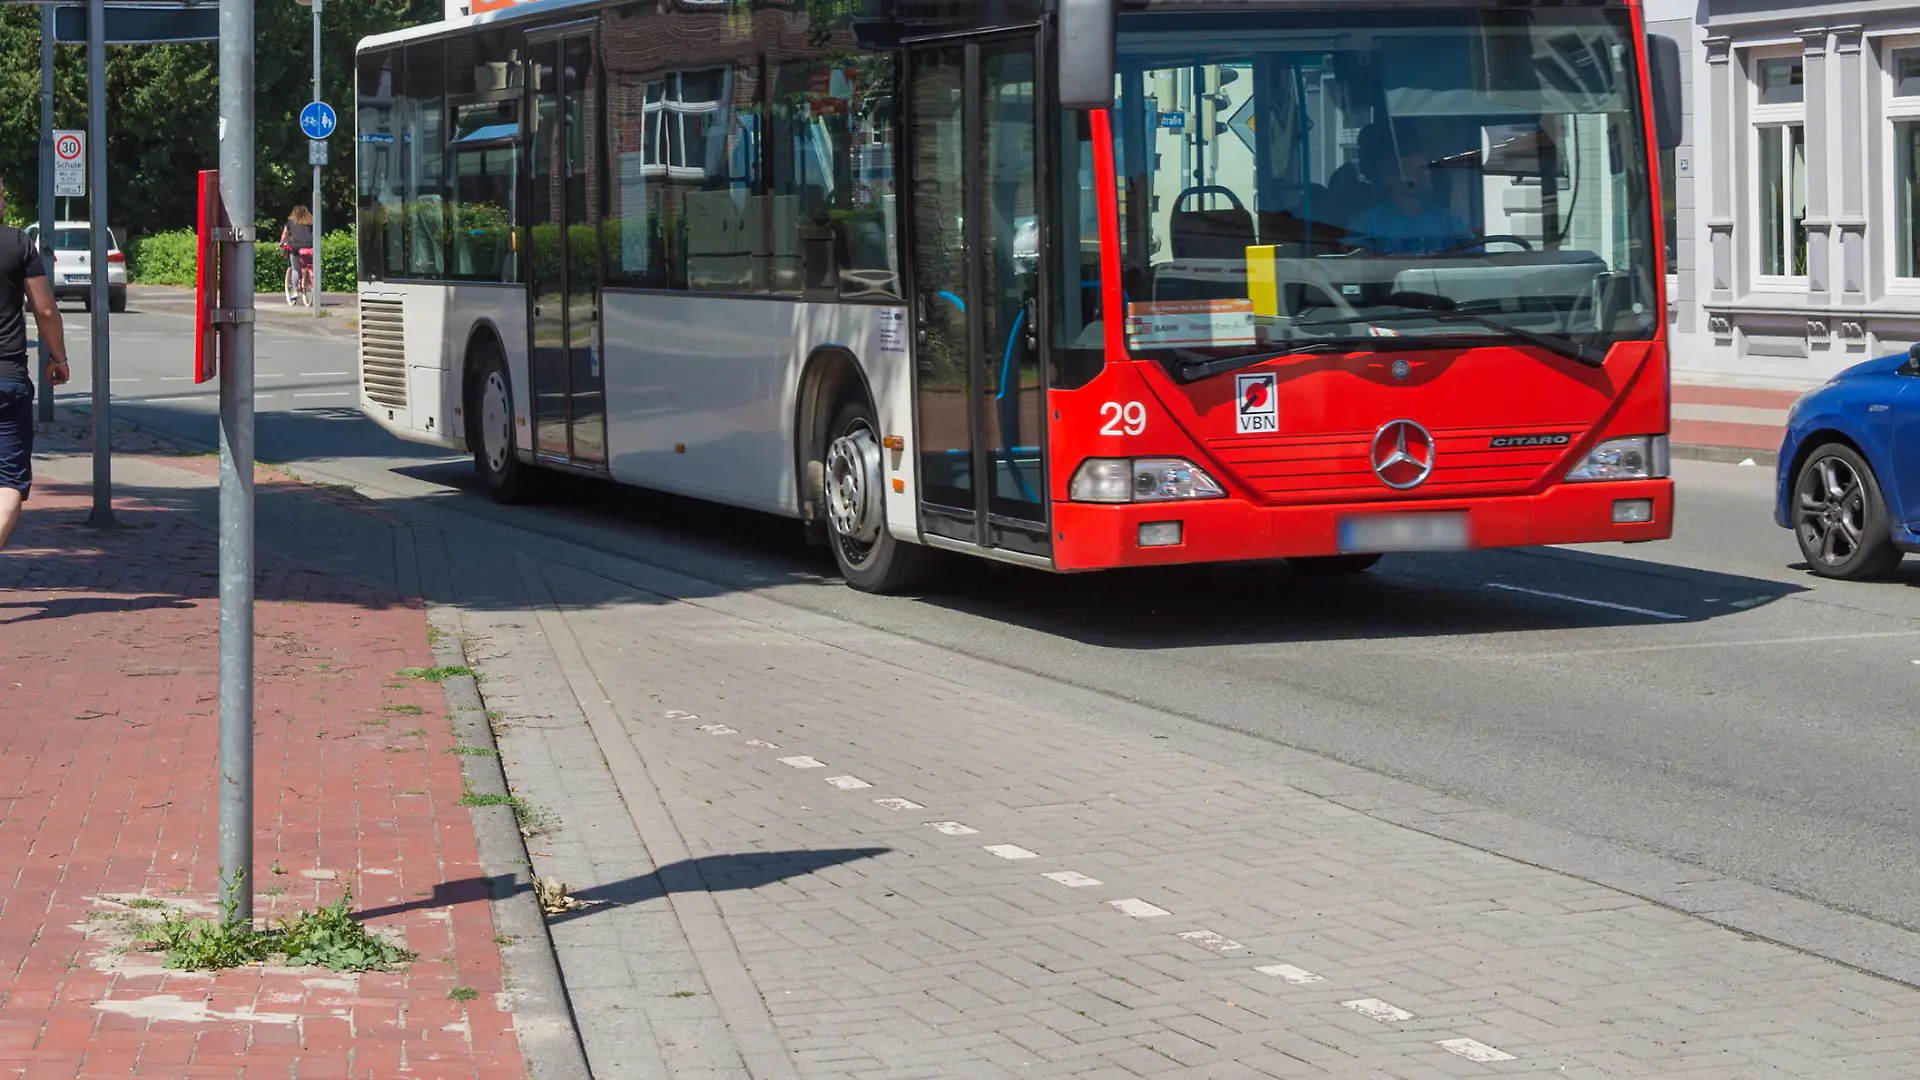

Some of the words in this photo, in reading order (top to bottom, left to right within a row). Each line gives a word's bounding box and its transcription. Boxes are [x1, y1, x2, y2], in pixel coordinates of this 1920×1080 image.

[61, 141, 77, 153] 30
[1099, 401, 1147, 436] 29
[1240, 415, 1276, 430] VBN
[1492, 435, 1568, 447] CITARO
